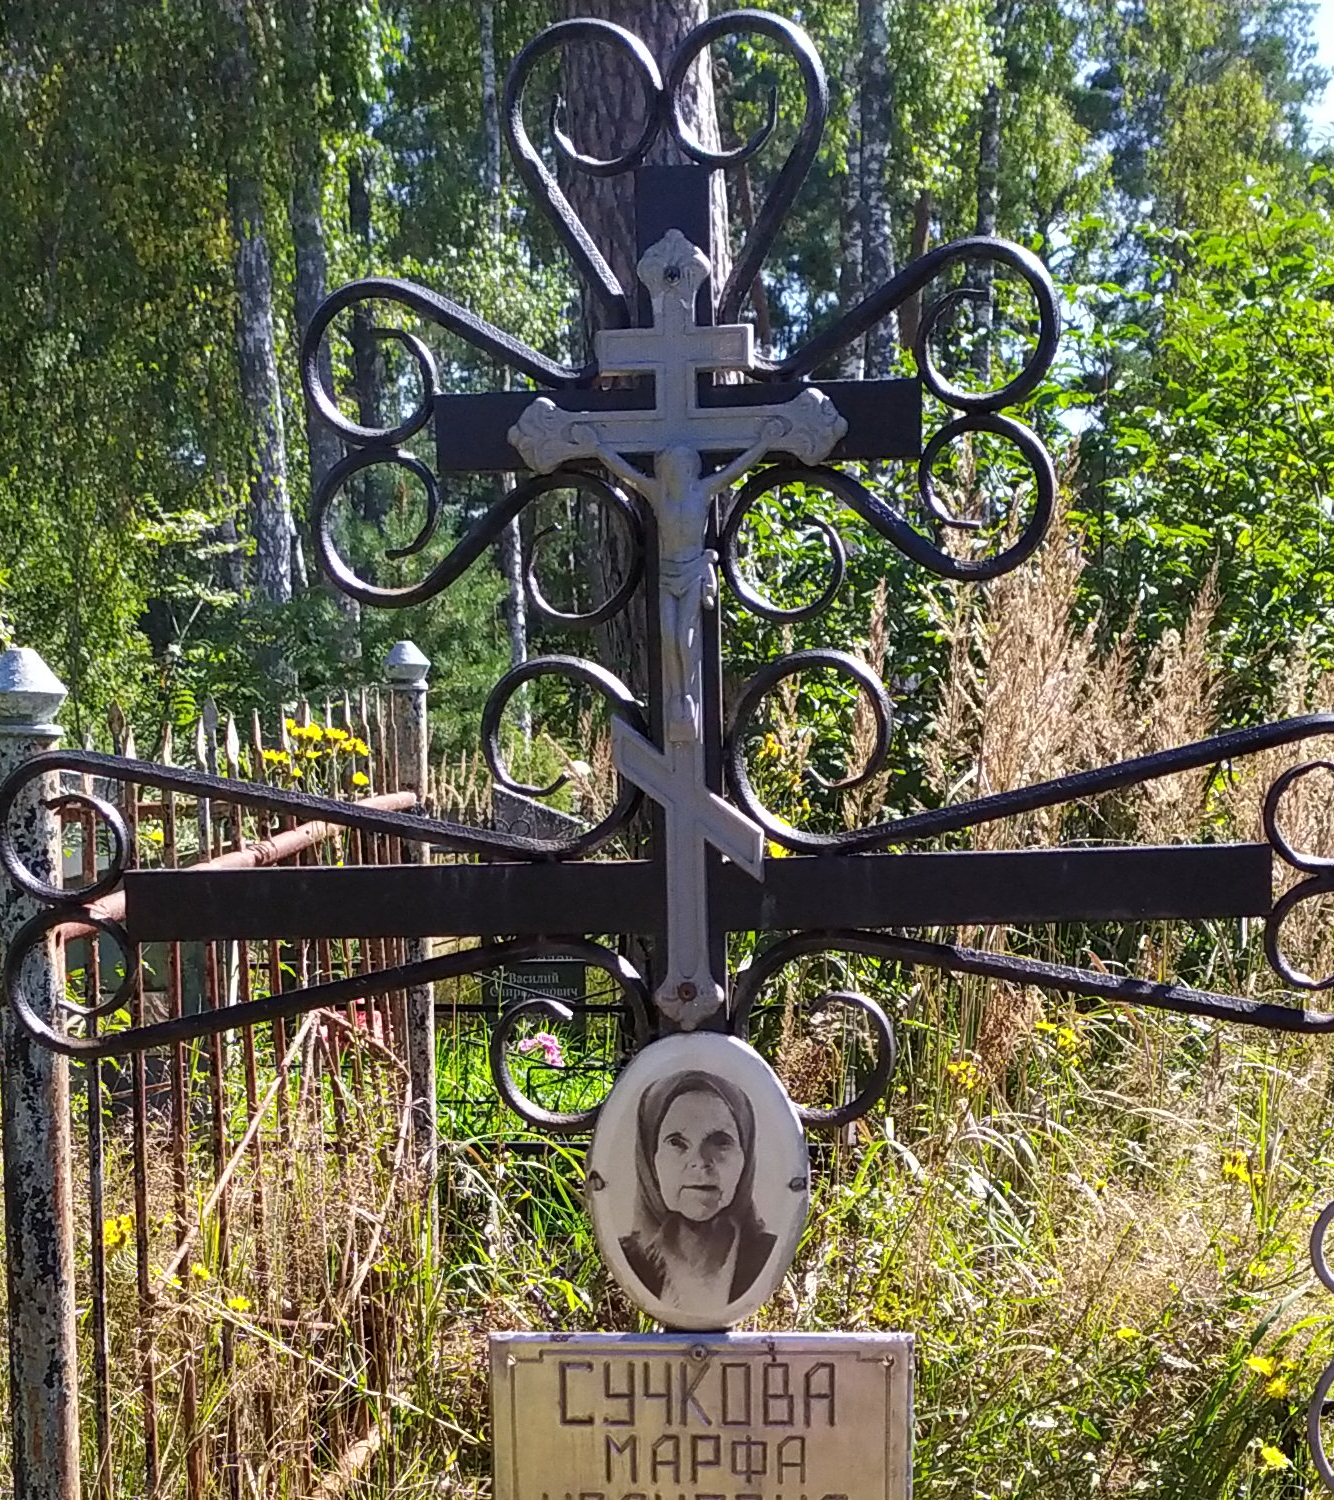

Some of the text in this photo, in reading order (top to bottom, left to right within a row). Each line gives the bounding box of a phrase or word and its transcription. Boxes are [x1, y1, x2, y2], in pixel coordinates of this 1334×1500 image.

[508, 973, 559, 984] Василий
[558, 1360, 836, 1428] СУЧКОВА
[605, 1434, 807, 1485] МАРФА
